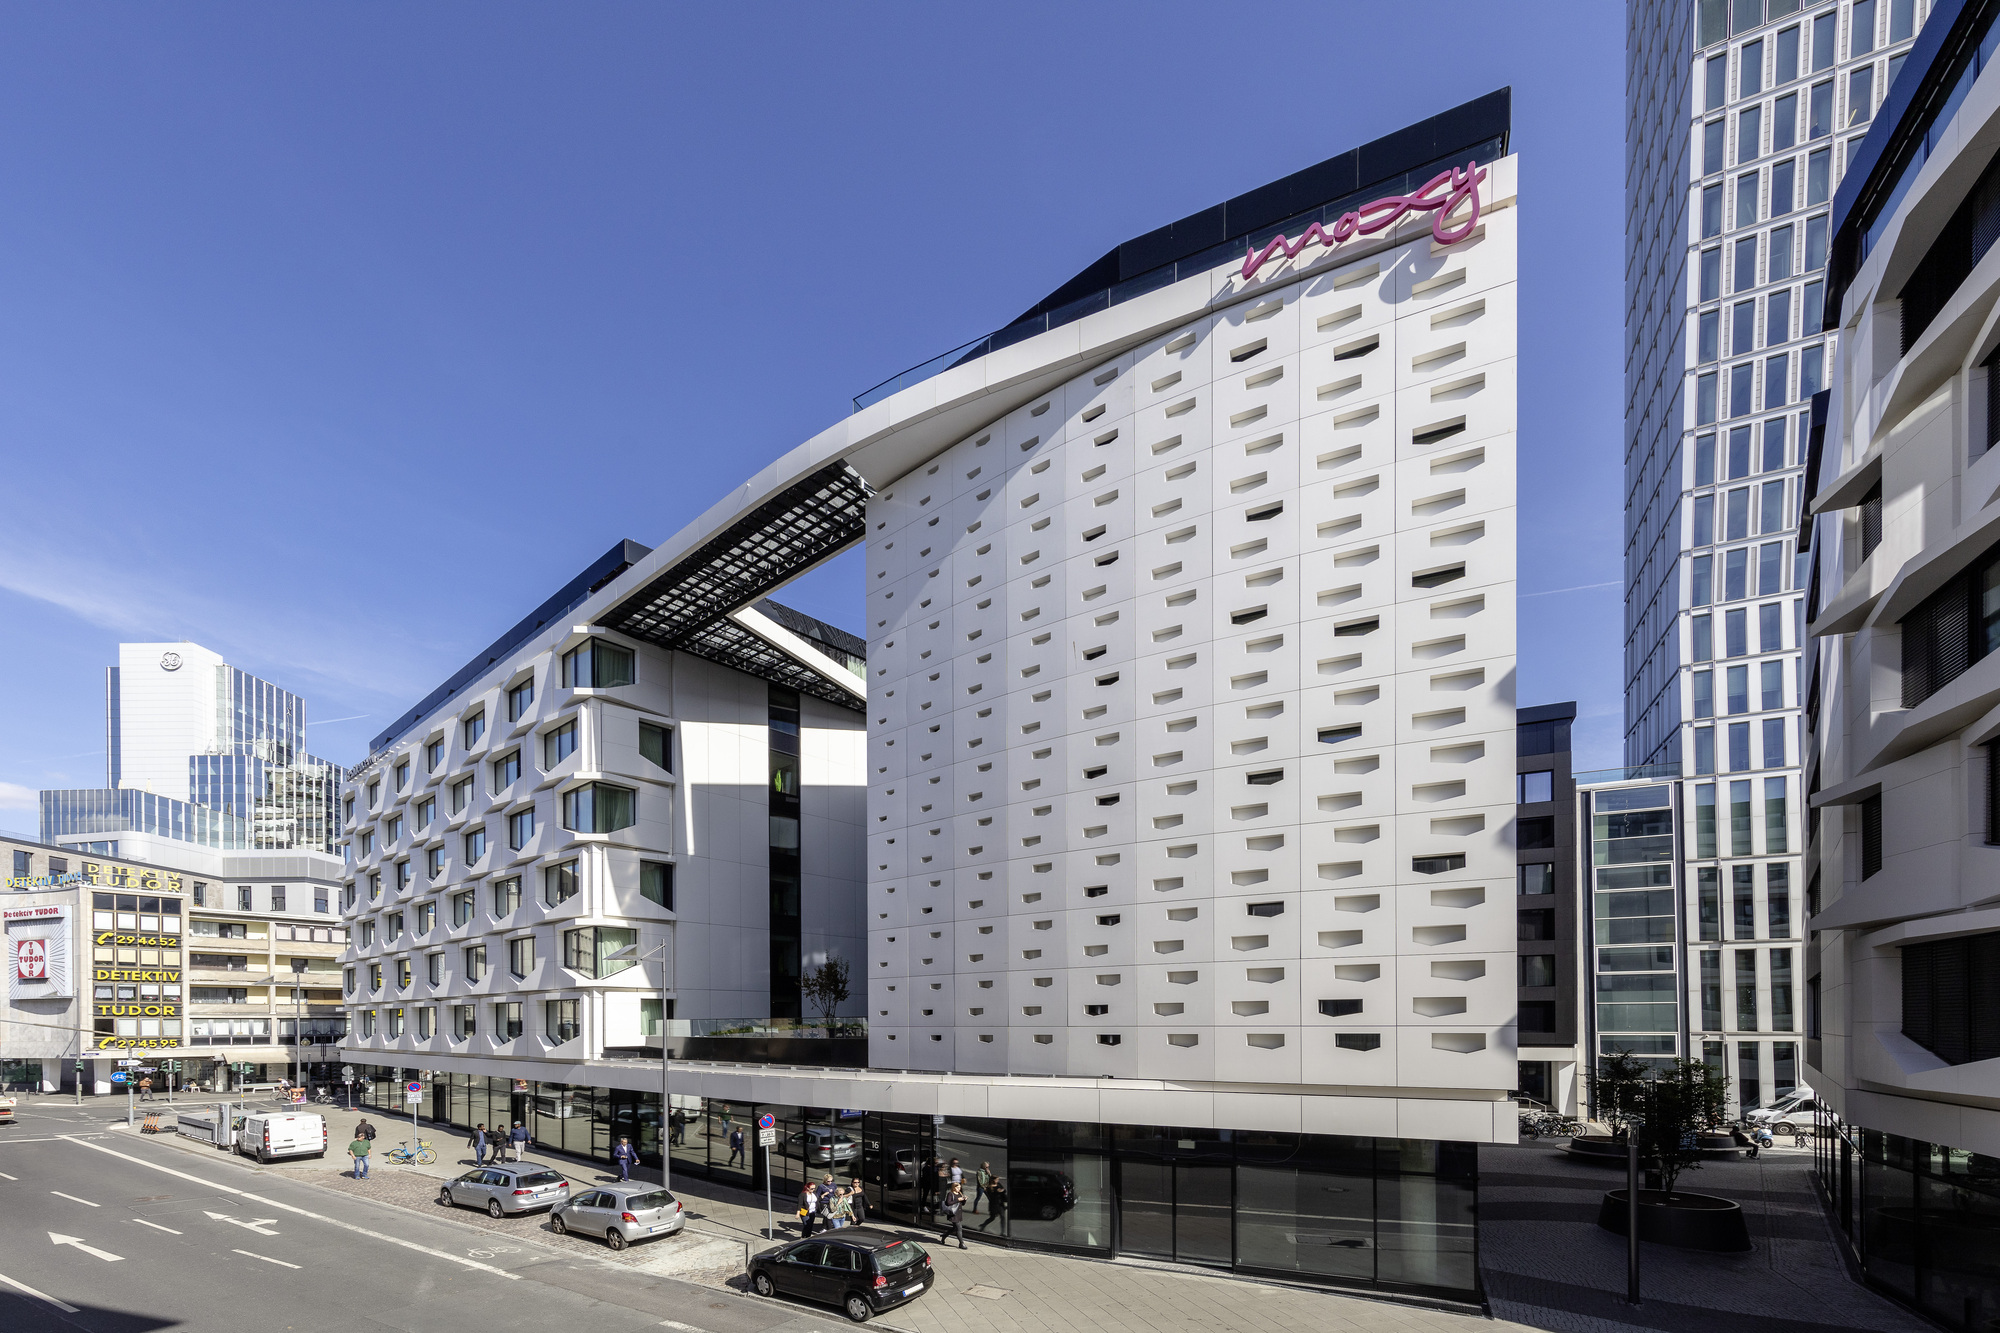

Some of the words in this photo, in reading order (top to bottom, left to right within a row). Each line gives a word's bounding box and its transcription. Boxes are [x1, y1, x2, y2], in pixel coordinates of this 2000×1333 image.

[1241, 160, 1487, 280] moxy
[87, 863, 181, 881] DETEKTIV
[5, 875, 55, 888] DETEKTIV
[88, 874, 181, 892] TUDOR
[3, 910, 33, 918] Detektiv
[35, 907, 59, 916] TUDOR
[117, 935, 136, 944] 29
[138, 936, 157, 945] 46
[160, 937, 177, 947] 52
[19, 955, 44, 963] TUDOR
[96, 969, 180, 982] DETEKTIV
[97, 1005, 176, 1016] TUDOR
[139, 1039, 158, 1048] 45
[160, 1039, 178, 1048] 95
[871, 1141, 880, 1149] 16
